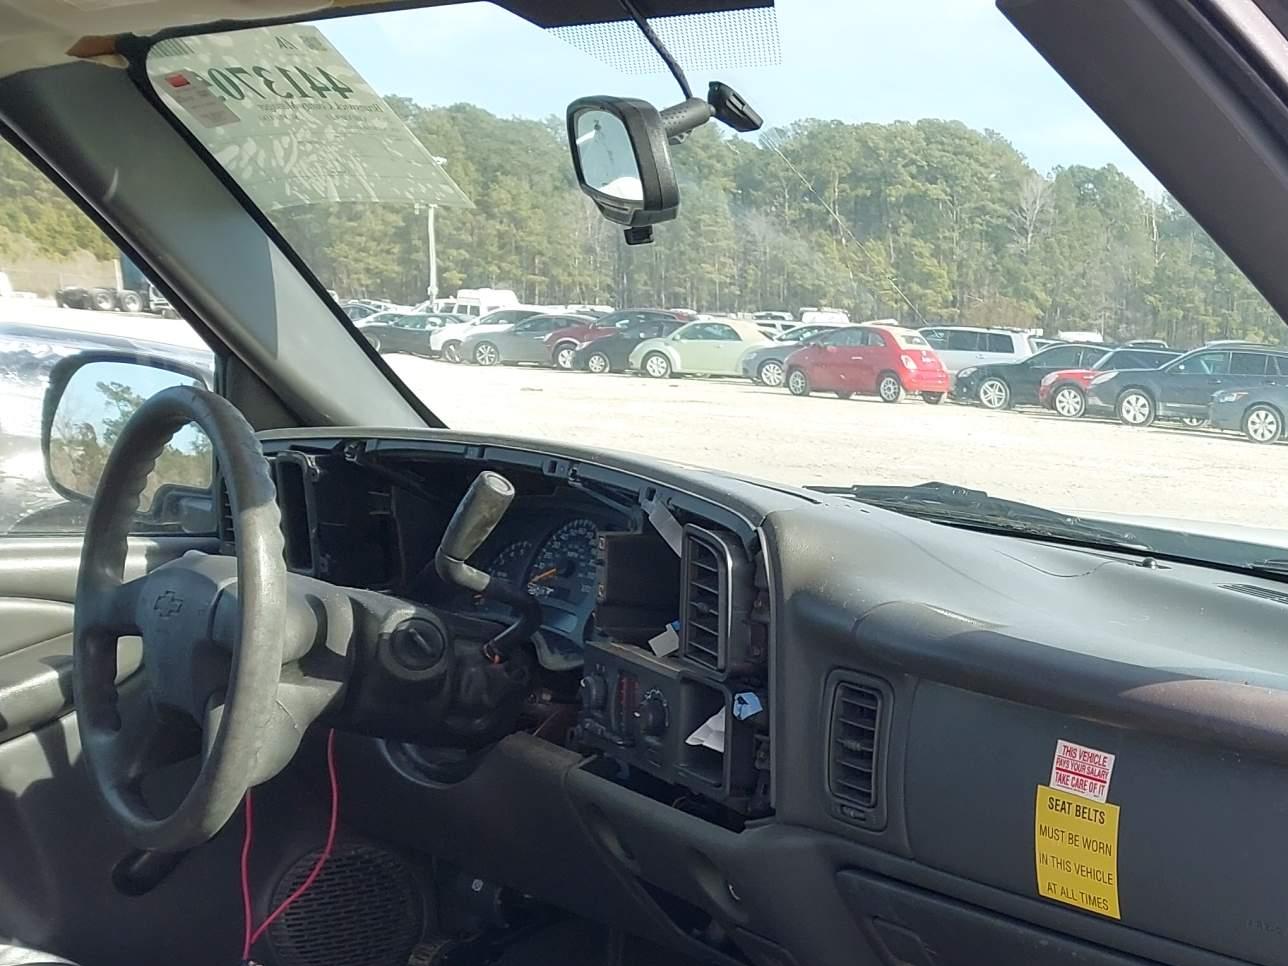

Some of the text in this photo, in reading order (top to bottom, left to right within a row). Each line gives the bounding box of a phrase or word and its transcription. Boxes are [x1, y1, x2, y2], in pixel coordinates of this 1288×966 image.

[1056, 757, 1109, 780] PAYS YOUR SALARY
[1062, 745, 1108, 768] THIS VEHICLE
[1055, 771, 1070, 786] TAKE
[1071, 776, 1088, 792] CARE
[1089, 781, 1098, 794] OF
[1098, 785, 1106, 797] IT
[1048, 796, 1105, 825] SEAT BELTS
[1040, 824, 1112, 857] MUST BE WORN
[1040, 852, 1113, 886] IN THIS VEHICLE
[1047, 881, 1109, 911] AT ALL TIMES
